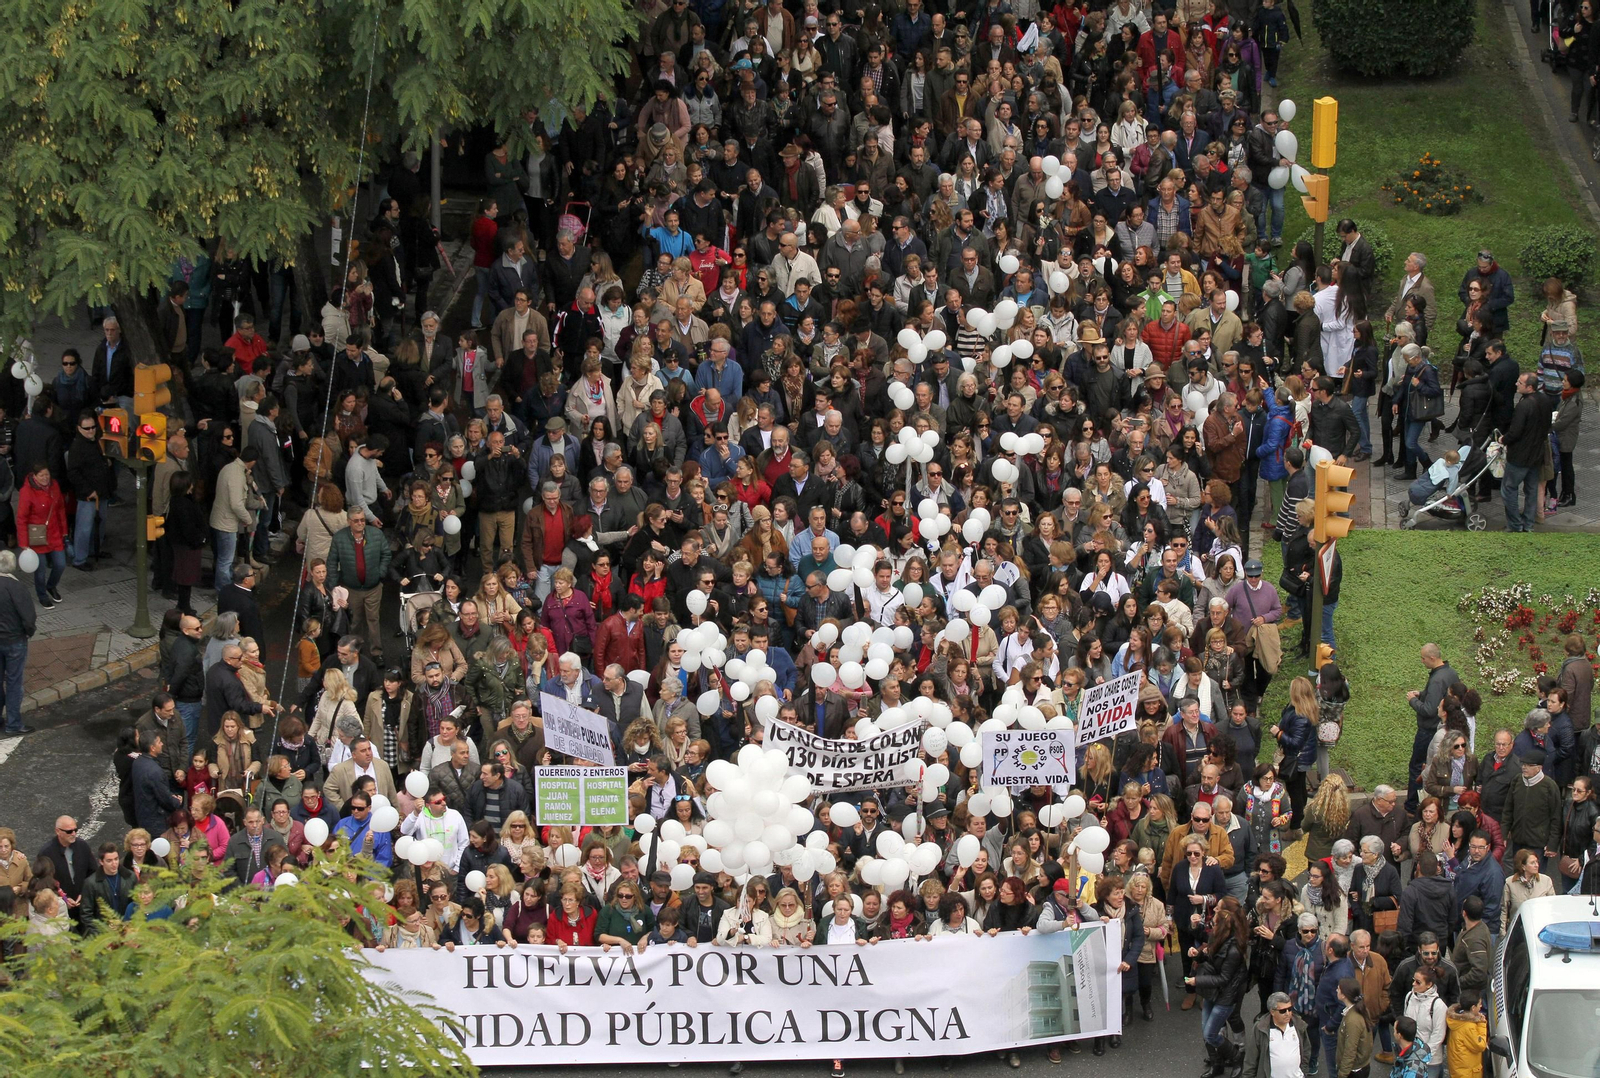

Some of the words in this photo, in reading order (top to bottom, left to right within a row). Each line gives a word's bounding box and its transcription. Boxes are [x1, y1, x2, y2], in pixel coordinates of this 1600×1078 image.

[569, 703, 579, 722] X
[1086, 700, 1109, 716] NOS
[1112, 694, 1126, 706] VA
[1081, 718, 1093, 731] LA
[1097, 702, 1132, 727] VIDA
[995, 733, 1011, 742] SU
[1018, 732, 1057, 742] JUEGO
[1080, 730, 1096, 743] EN
[1099, 720, 1128, 736] ELLO
[553, 735, 566, 753] DE
[569, 740, 605, 764] CALIDAD
[848, 740, 866, 753] DE
[994, 748, 1008, 756] PP
[1050, 745, 1063, 754] PSOE
[785, 746, 817, 768] 130
[821, 754, 857, 768] DÍAS
[863, 752, 885, 770] EN
[888, 746, 919, 767] LIST
[1012, 744, 1027, 771] CHARE
[1032, 744, 1047, 771] COSTA
[538, 768, 581, 777] QUEREMOS
[583, 768, 588, 776] 2
[590, 767, 625, 776] ENTEROS
[807, 772, 824, 786] DE
[832, 768, 895, 788] ESPERA
[991, 775, 1039, 785] NUESTRA
[1045, 774, 1069, 784] VIDA
[541, 781, 577, 790] HOSPITAL
[587, 780, 623, 789] HOSPITAL
[546, 792, 568, 800] JUAN
[589, 795, 619, 803] INFANTA
[591, 807, 616, 816] ELENA
[462, 952, 654, 994] HUELVA,
[667, 951, 765, 988] POR
[773, 953, 874, 987] UNA
[1077, 949, 1086, 990] Hospital
[413, 1012, 592, 1049] NIDAD
[605, 1001, 807, 1047] PÚBLICA
[817, 1006, 971, 1042] DIGNA
